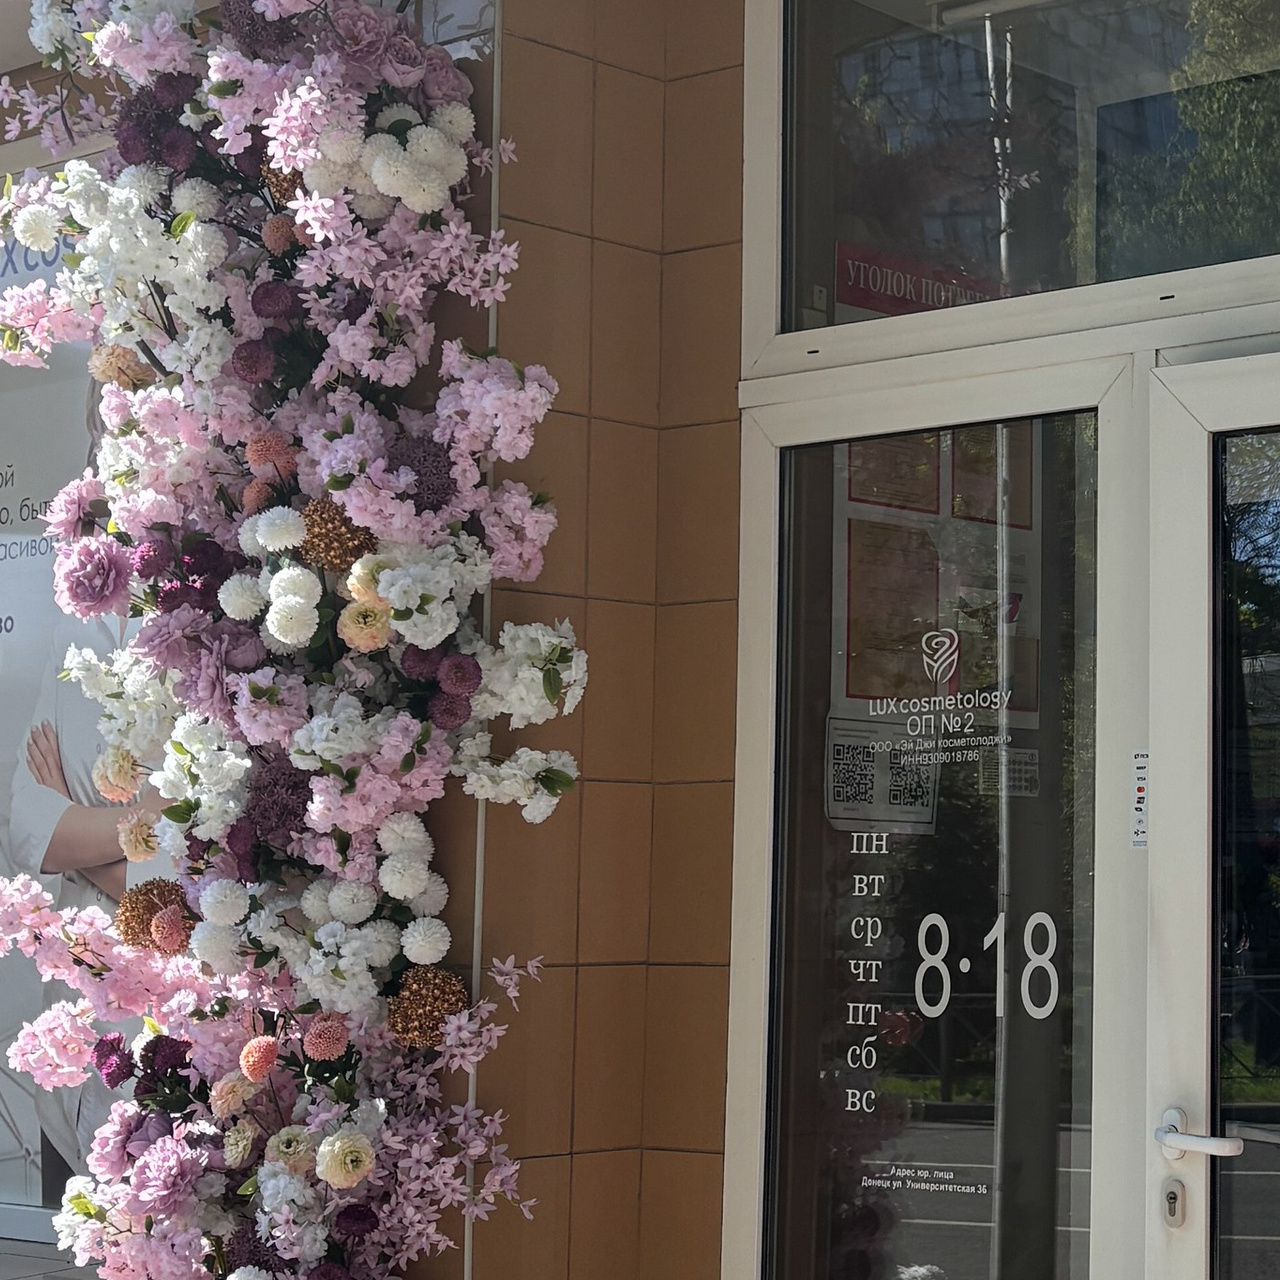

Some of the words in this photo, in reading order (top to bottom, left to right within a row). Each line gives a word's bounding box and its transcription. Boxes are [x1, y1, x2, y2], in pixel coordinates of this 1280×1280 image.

[847, 260, 917, 302] УГОЛОК
[906, 715, 935, 736] ОП
[869, 740, 893, 753] ООО
[915, 737, 936, 752] Джи
[889, 1165, 916, 1179] Адрес
[917, 1168, 932, 1179] юр.
[933, 1169, 954, 1180] лица
[861, 1176, 891, 1188] Донецк
[906, 1179, 976, 1193] Университетская
[977, 1184, 988, 1194] 36
